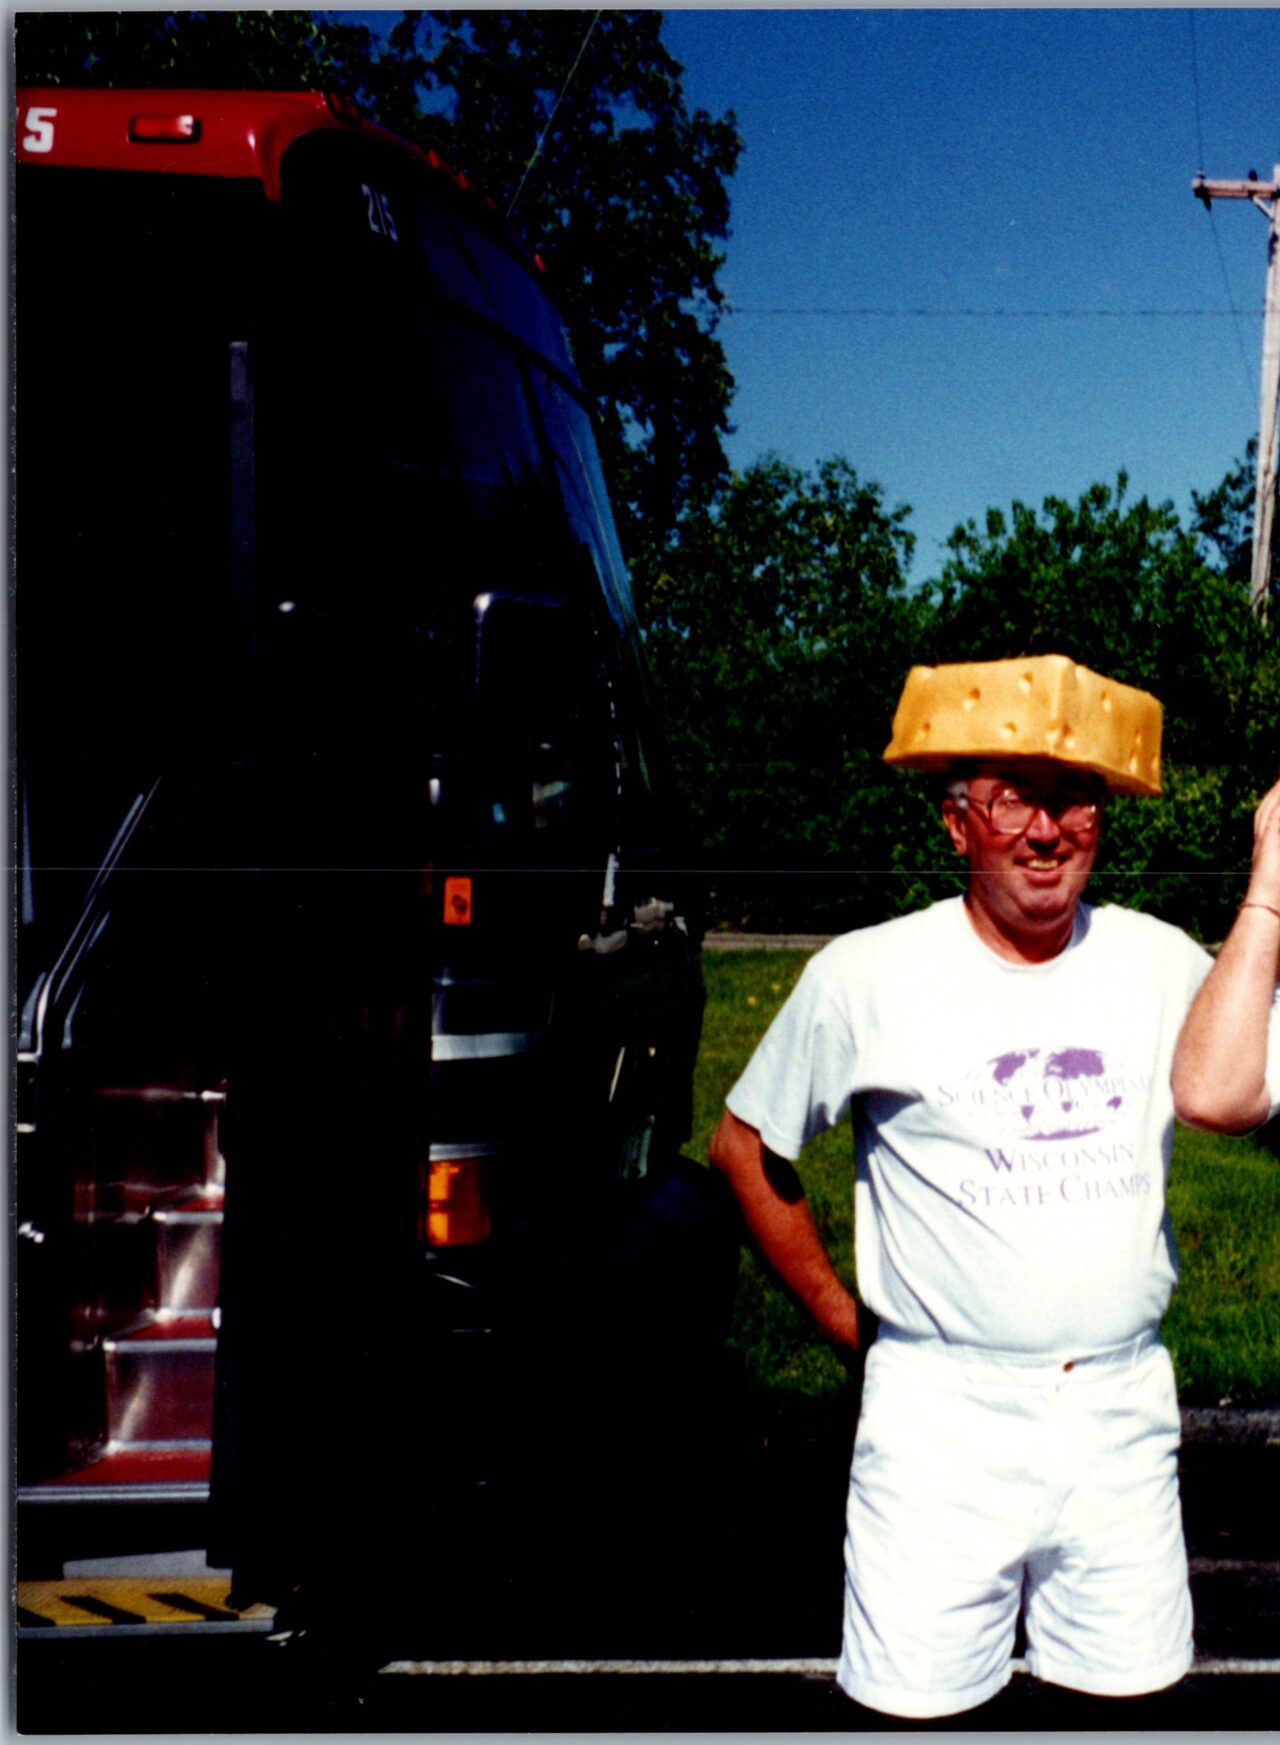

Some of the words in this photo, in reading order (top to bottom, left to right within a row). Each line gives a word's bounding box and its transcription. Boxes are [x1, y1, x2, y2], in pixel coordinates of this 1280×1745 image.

[16, 107, 58, 153] 5
[361, 183, 399, 242] 215
[984, 1143, 1134, 1172] WISCONSIN
[959, 1179, 1049, 1206] STATE
[1060, 1171, 1151, 1203] CHAMPS
